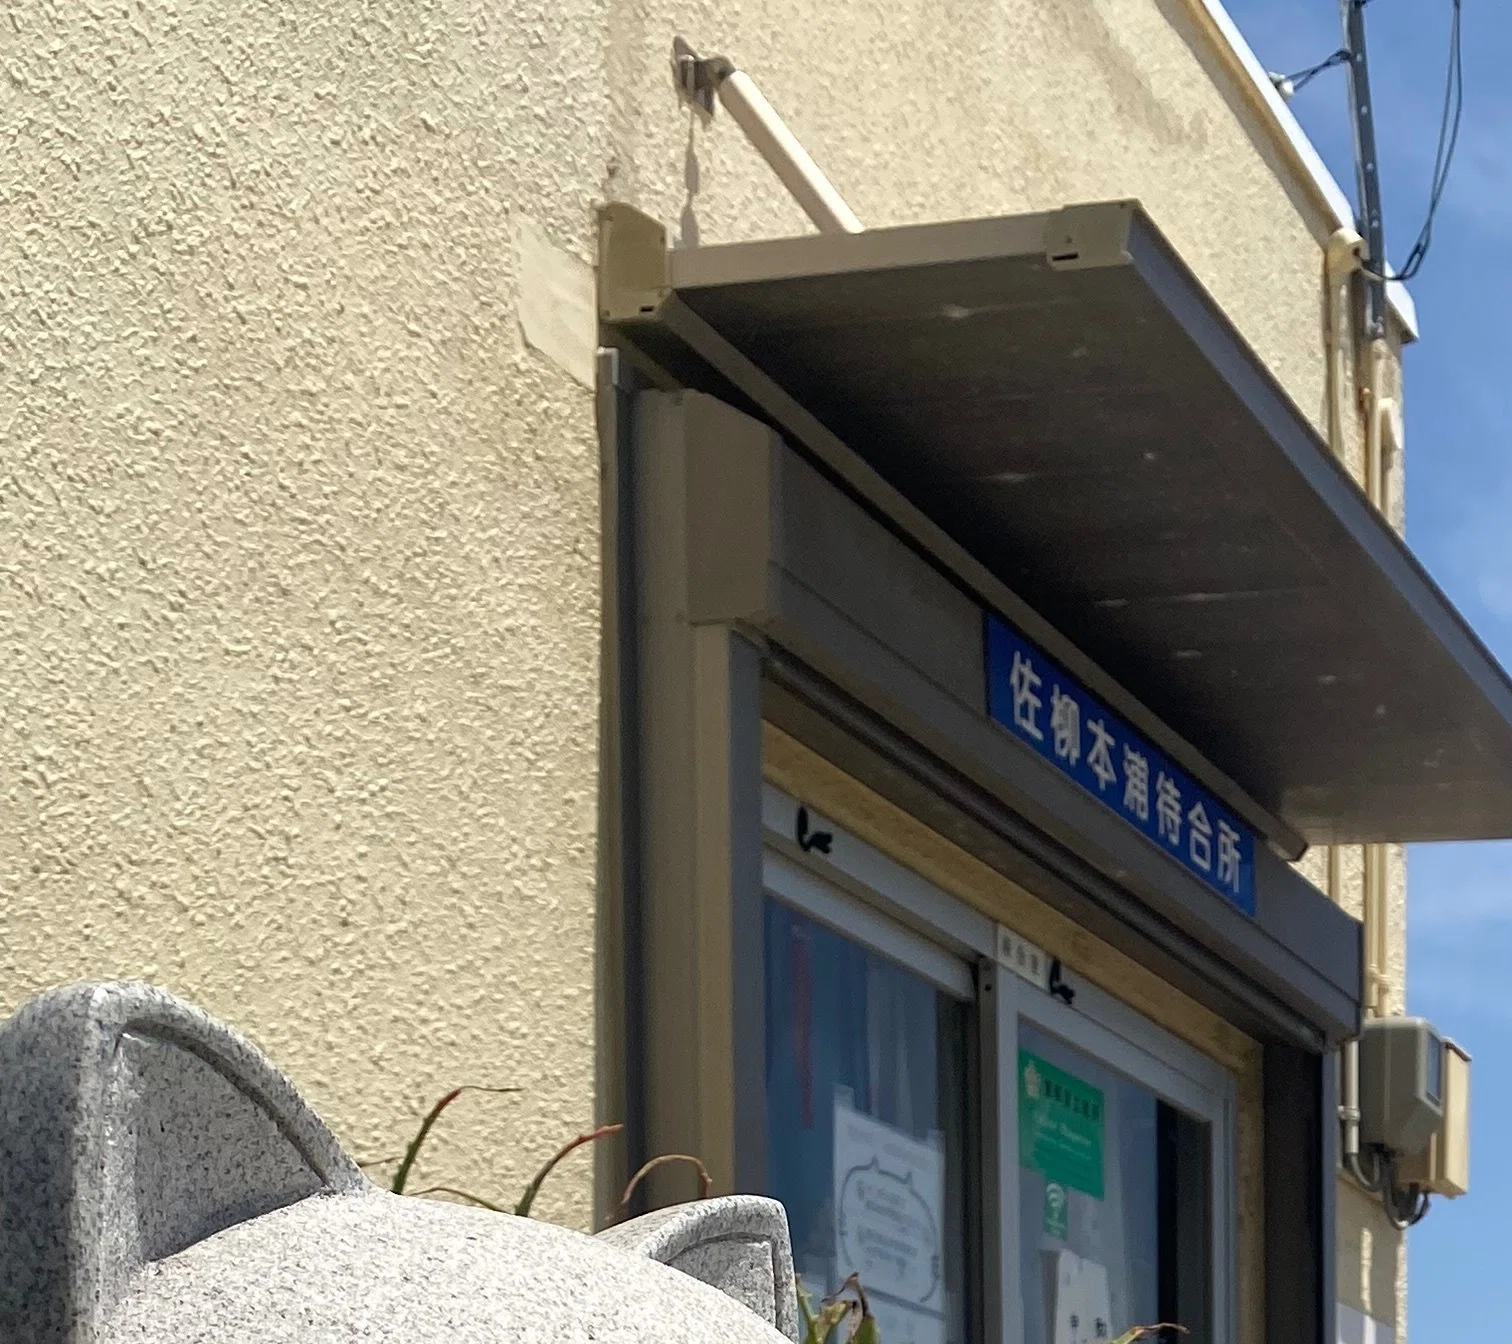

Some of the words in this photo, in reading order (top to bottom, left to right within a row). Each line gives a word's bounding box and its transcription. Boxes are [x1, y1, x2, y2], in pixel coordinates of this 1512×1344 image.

[1010, 650, 1241, 893] 佐柳本浦待合所
